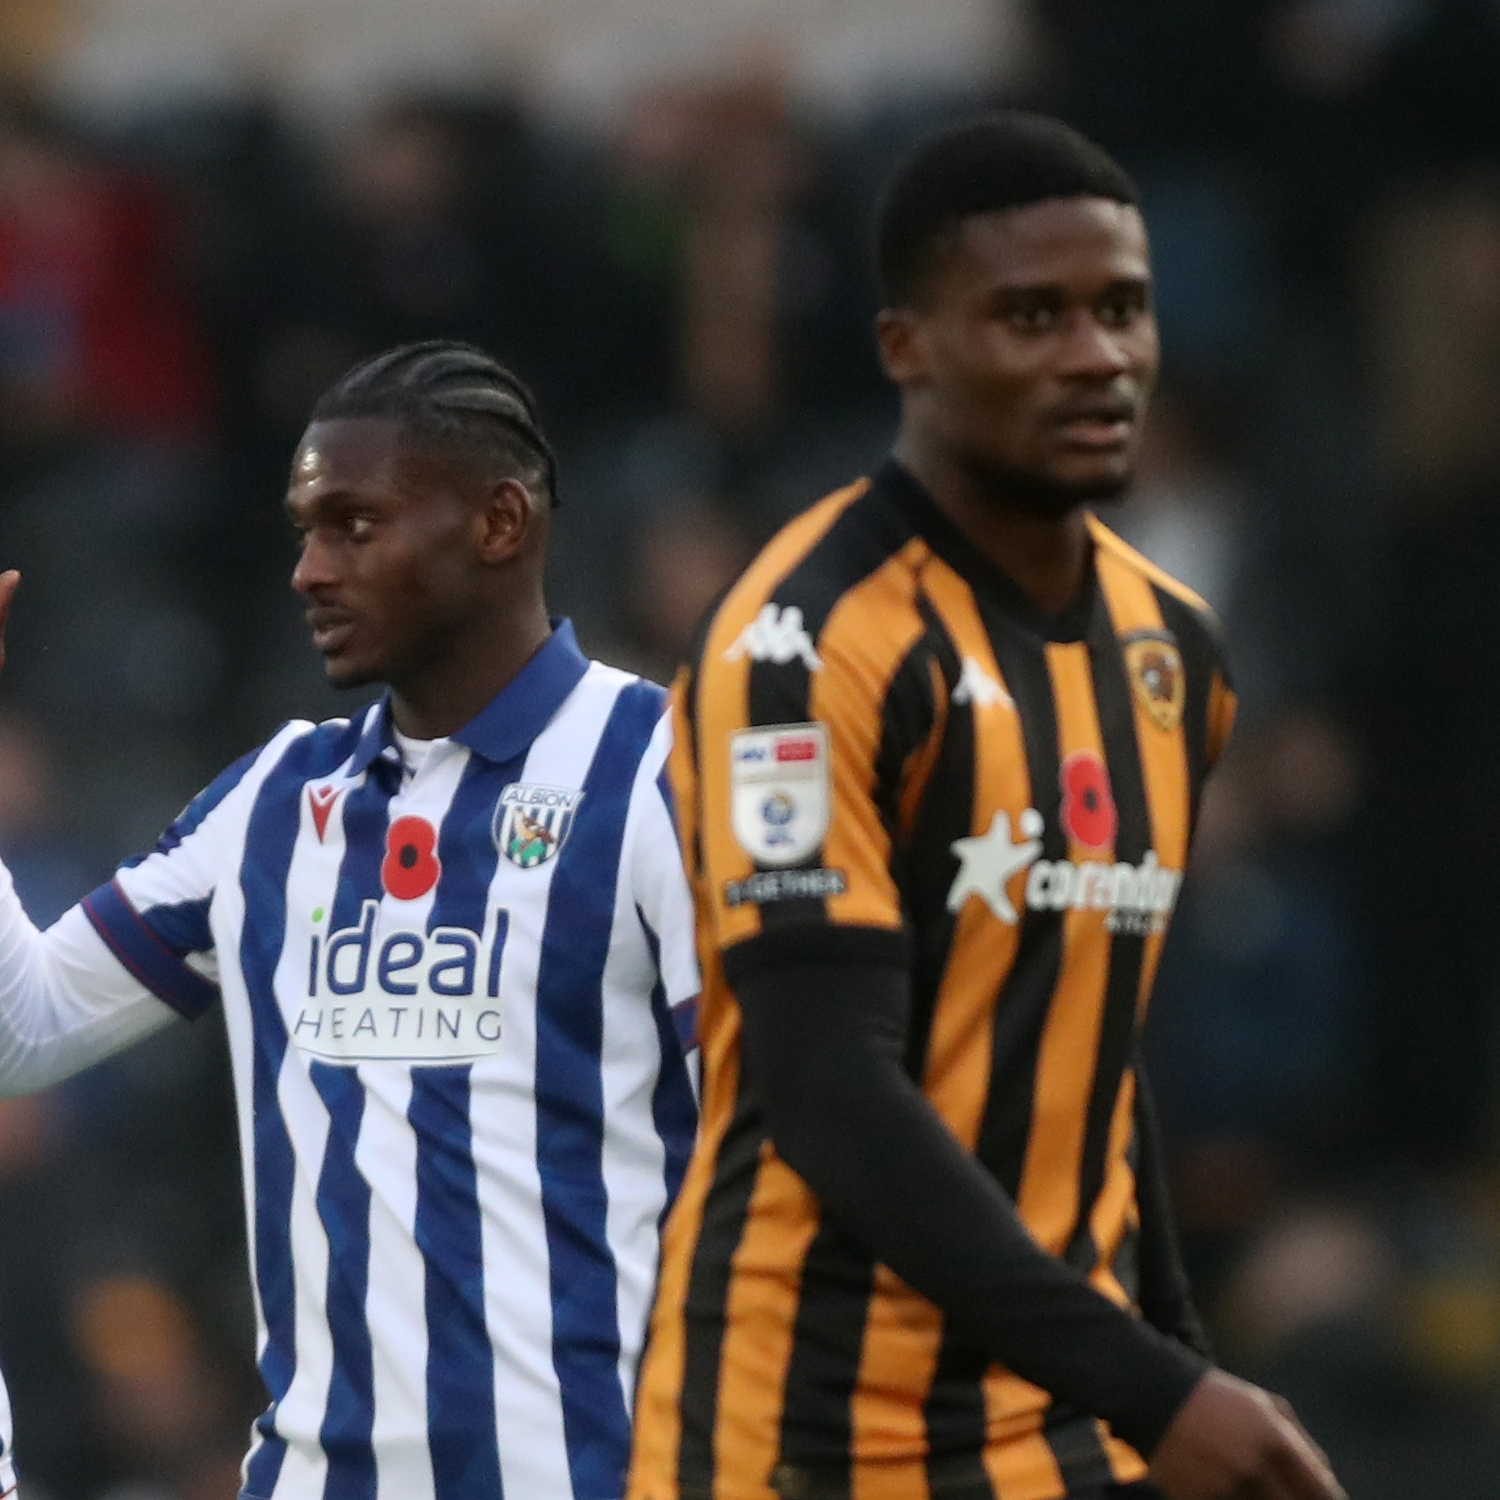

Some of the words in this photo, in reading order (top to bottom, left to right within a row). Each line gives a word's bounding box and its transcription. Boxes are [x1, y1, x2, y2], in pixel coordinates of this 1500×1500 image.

[504, 789, 574, 808] ALBION
[308, 902, 509, 998] ideal
[294, 1006, 502, 1041] HEATING
